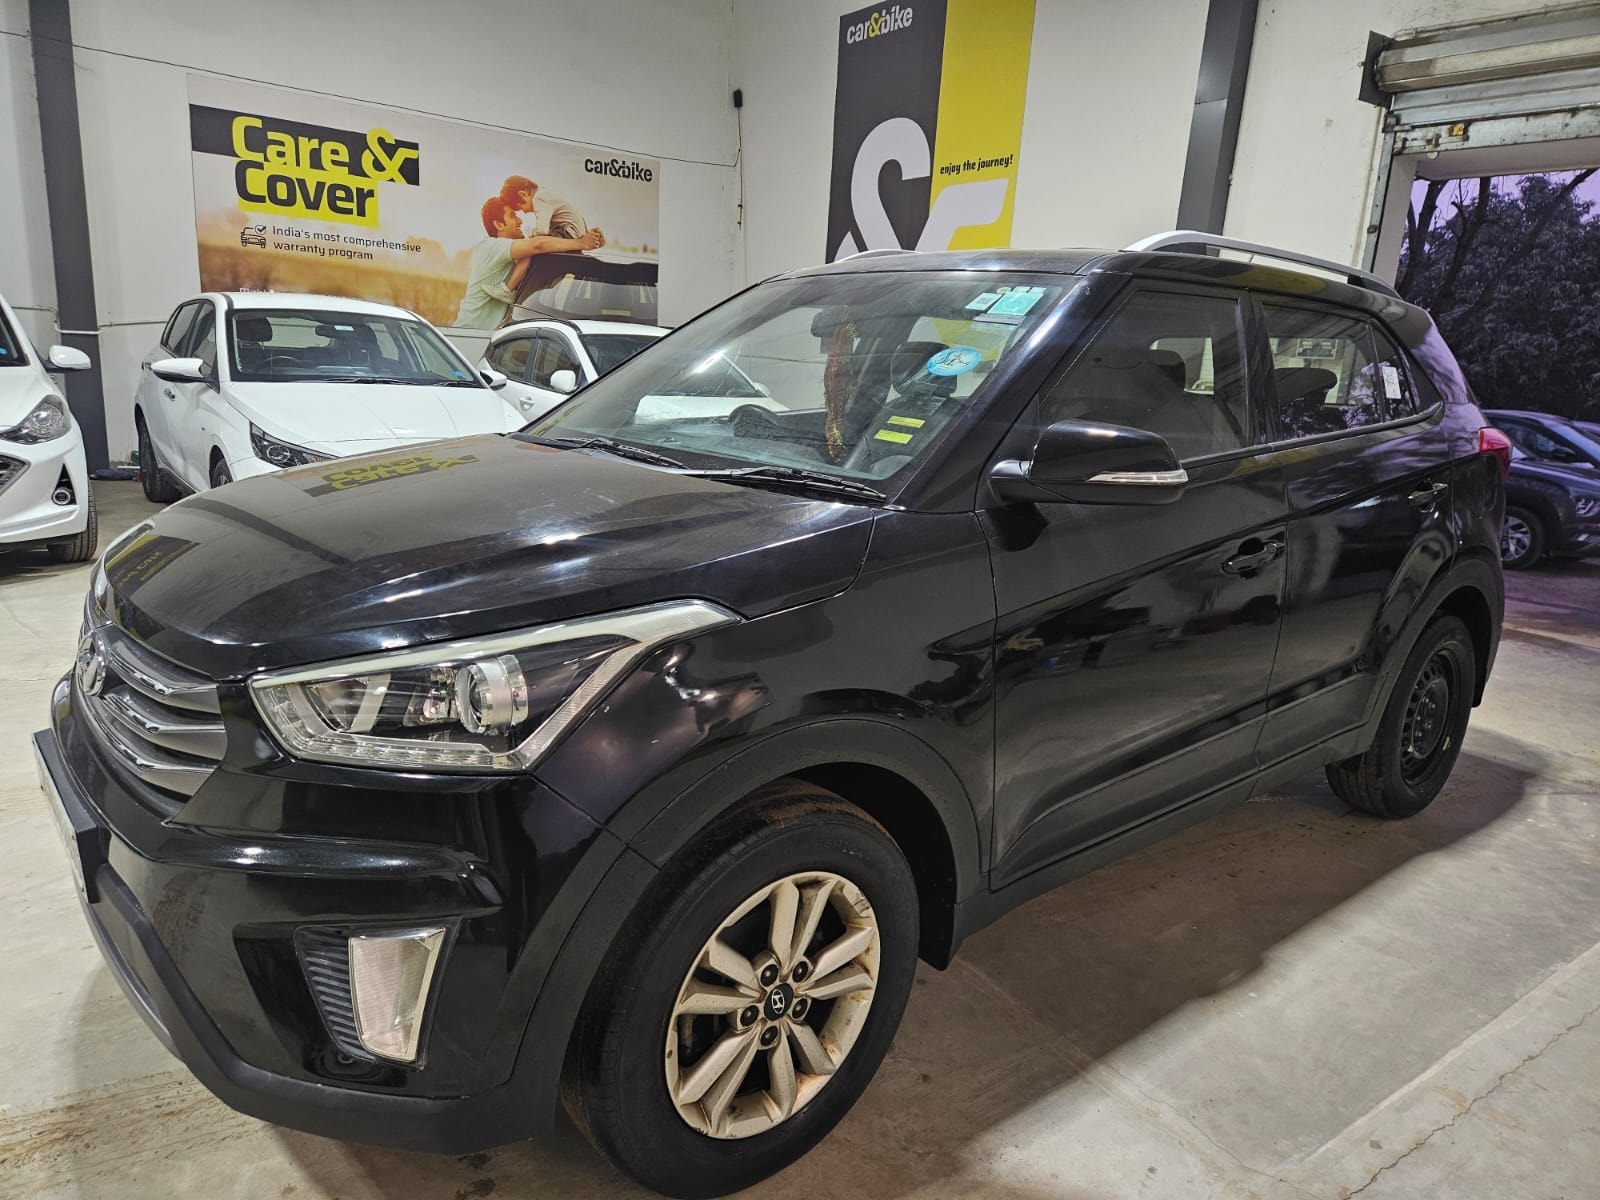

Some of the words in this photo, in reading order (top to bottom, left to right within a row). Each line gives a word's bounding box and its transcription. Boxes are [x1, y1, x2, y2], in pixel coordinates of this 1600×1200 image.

[846, 5, 913, 44] car&bike
[232, 115, 349, 176] Care
[361, 127, 419, 184] &
[584, 158, 653, 182] car&bike
[940, 162, 961, 176] enjoy
[963, 159, 977, 171] the
[977, 153, 1014, 172] journey!
[235, 159, 375, 218] Cover
[272, 225, 311, 240] India's
[313, 230, 341, 243] most
[343, 234, 422, 254] comprehensive
[273, 240, 326, 257] warranty
[328, 247, 374, 261] program
